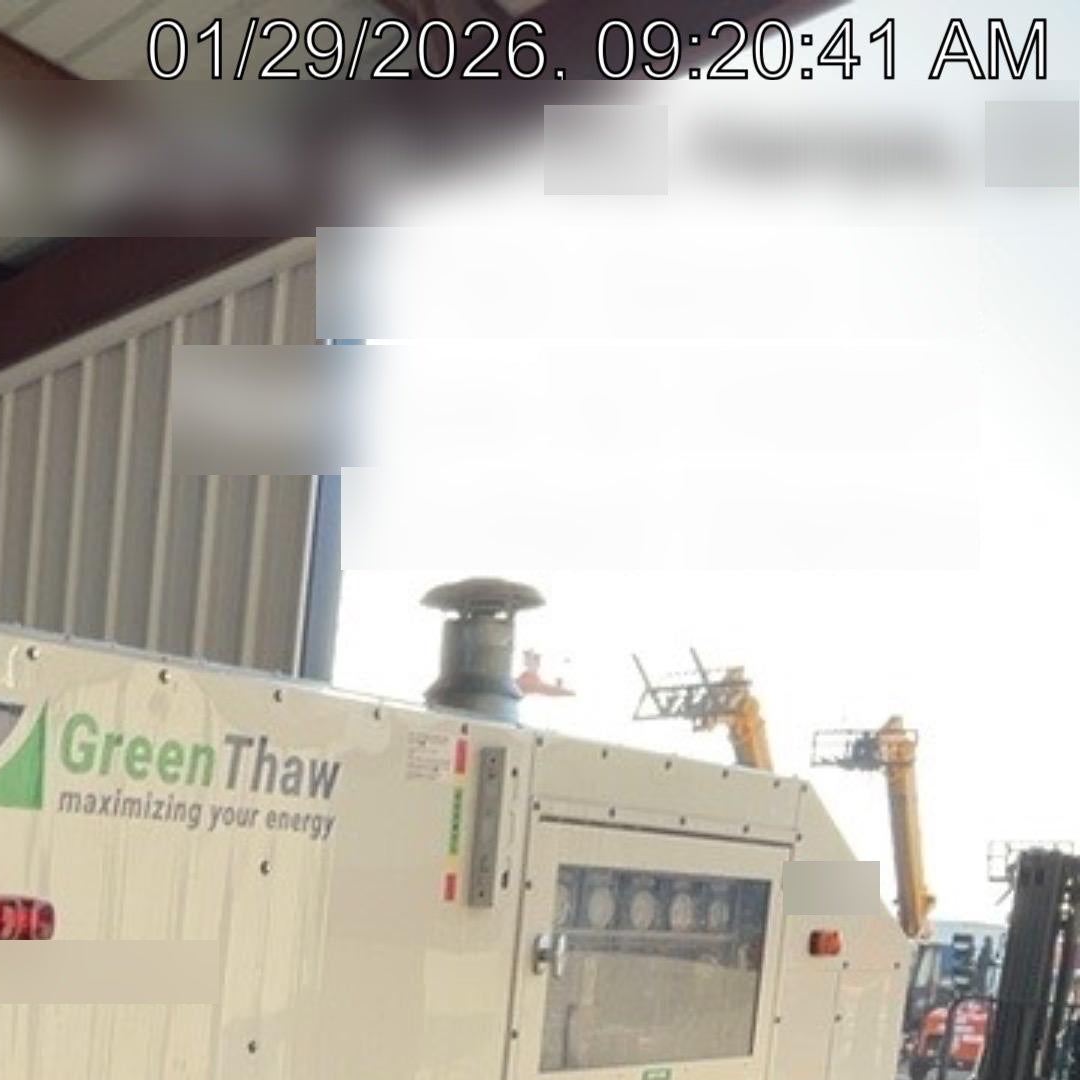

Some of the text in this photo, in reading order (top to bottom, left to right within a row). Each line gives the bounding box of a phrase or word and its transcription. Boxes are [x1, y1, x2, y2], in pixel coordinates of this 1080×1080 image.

[58, 789, 336, 841] maximizing your energy
